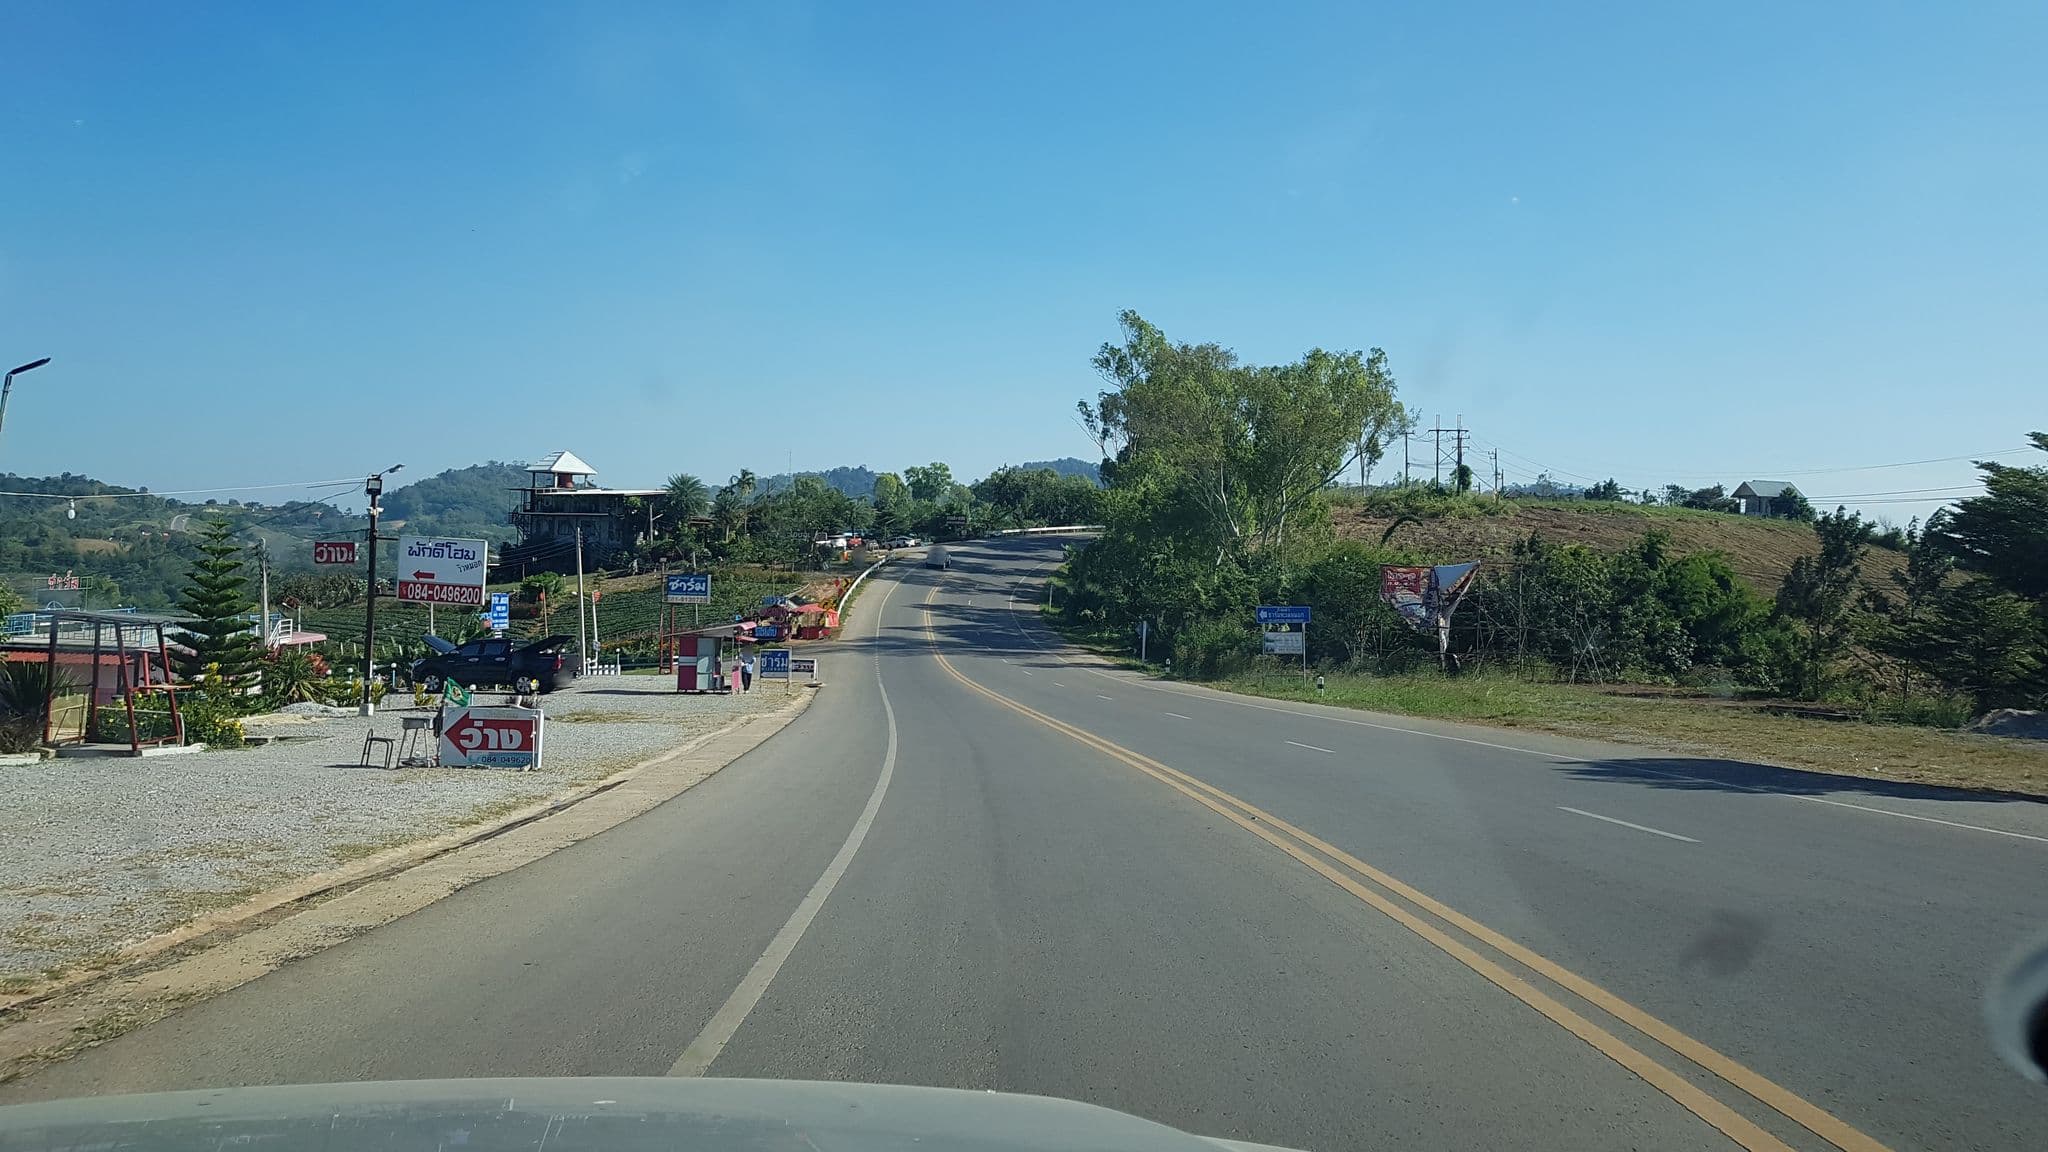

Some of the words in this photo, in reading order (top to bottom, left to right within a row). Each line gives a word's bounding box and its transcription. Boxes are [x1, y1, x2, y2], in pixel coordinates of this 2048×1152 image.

[316, 543, 348, 563] ว่าง
[407, 583, 480, 604] 084-0496200
[459, 720, 523, 750] ว่าง
